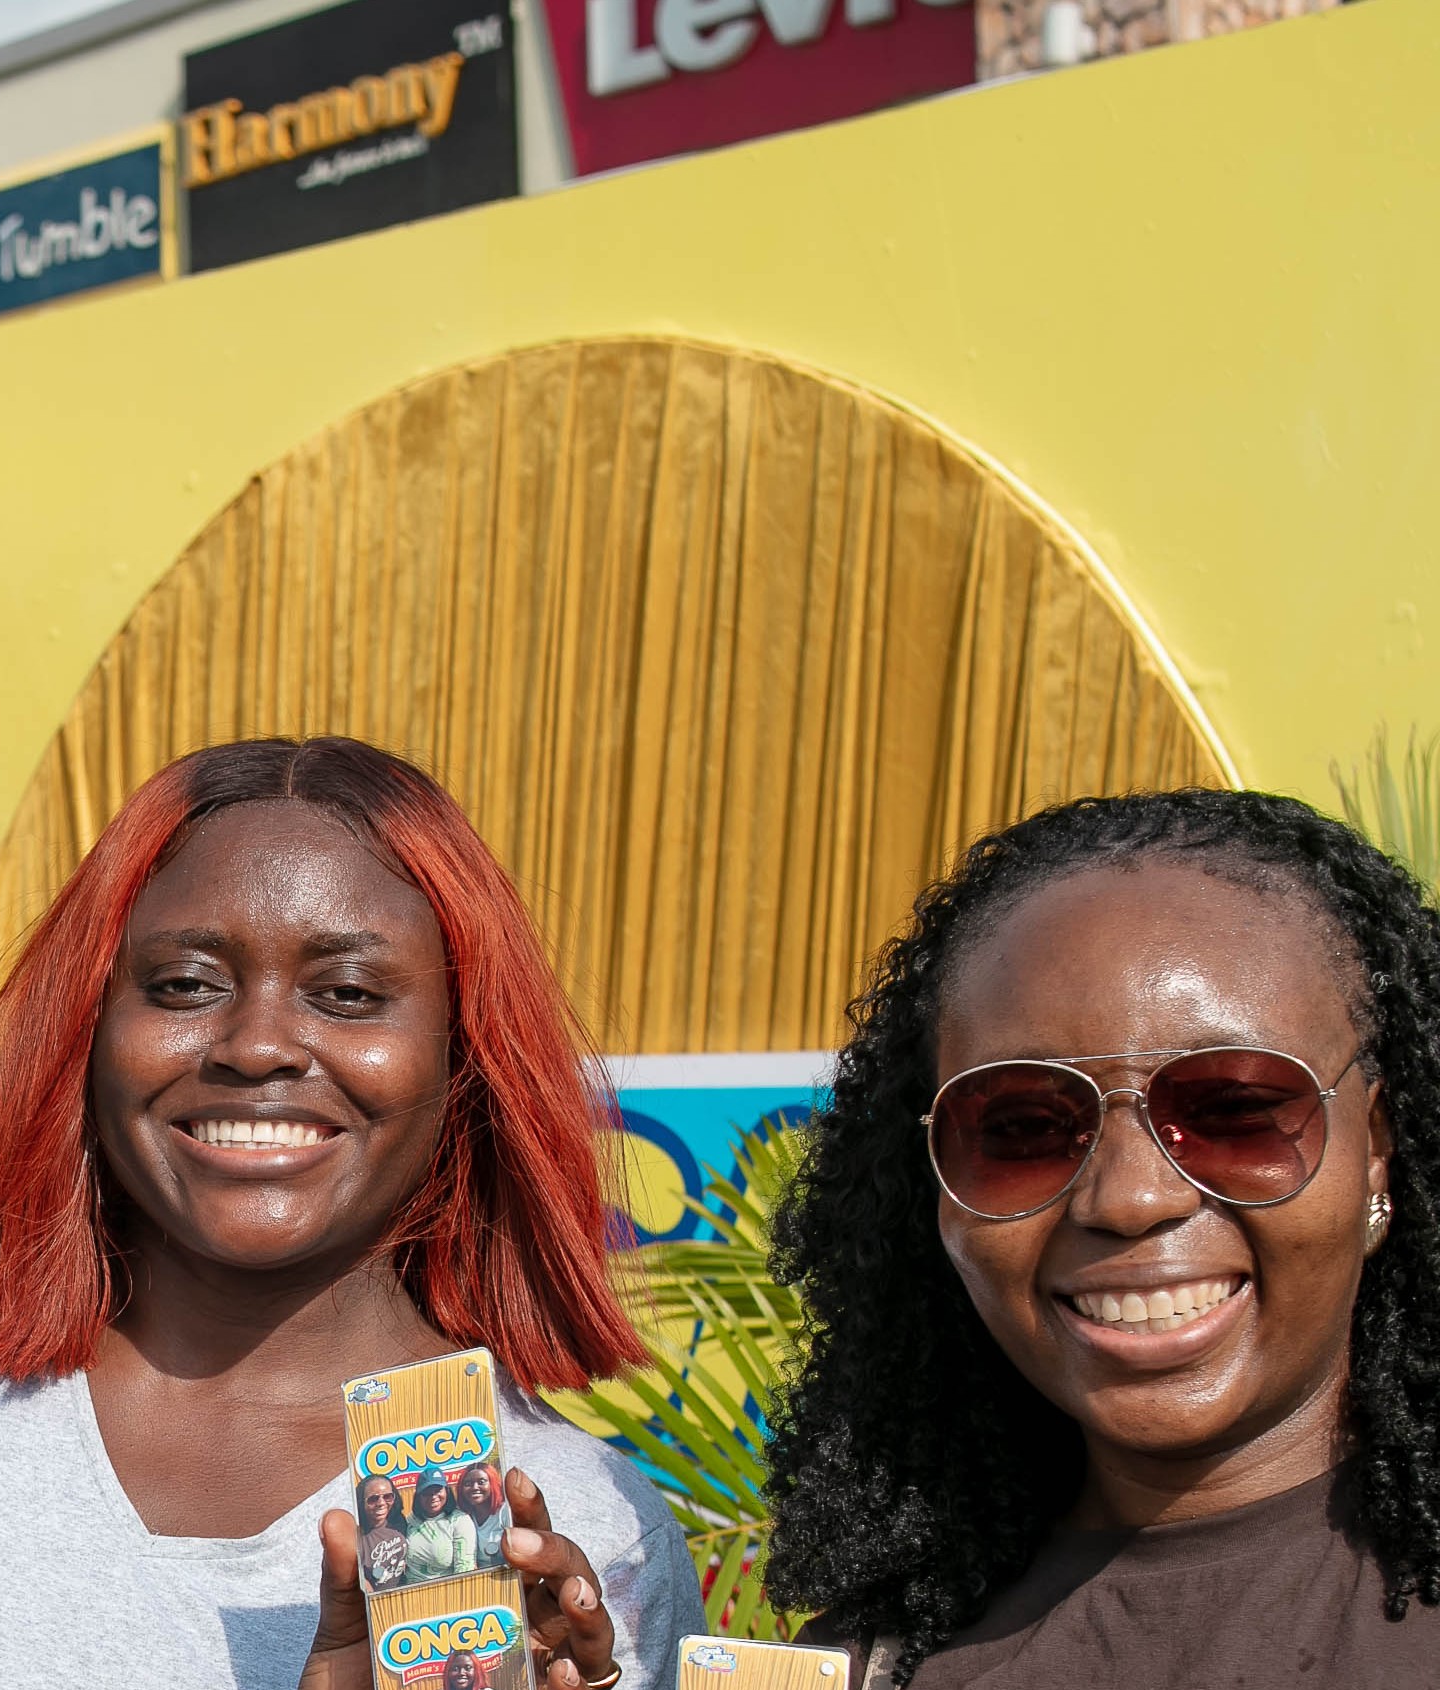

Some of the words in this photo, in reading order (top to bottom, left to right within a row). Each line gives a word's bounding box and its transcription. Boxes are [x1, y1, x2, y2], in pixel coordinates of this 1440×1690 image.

[182, 51, 464, 189] Harmony
[366, 1425, 482, 1475] ONGA
[389, 1613, 507, 1664] ONGA
[406, 1664, 440, 1680] Mama's
[481, 1656, 500, 1670] and!
